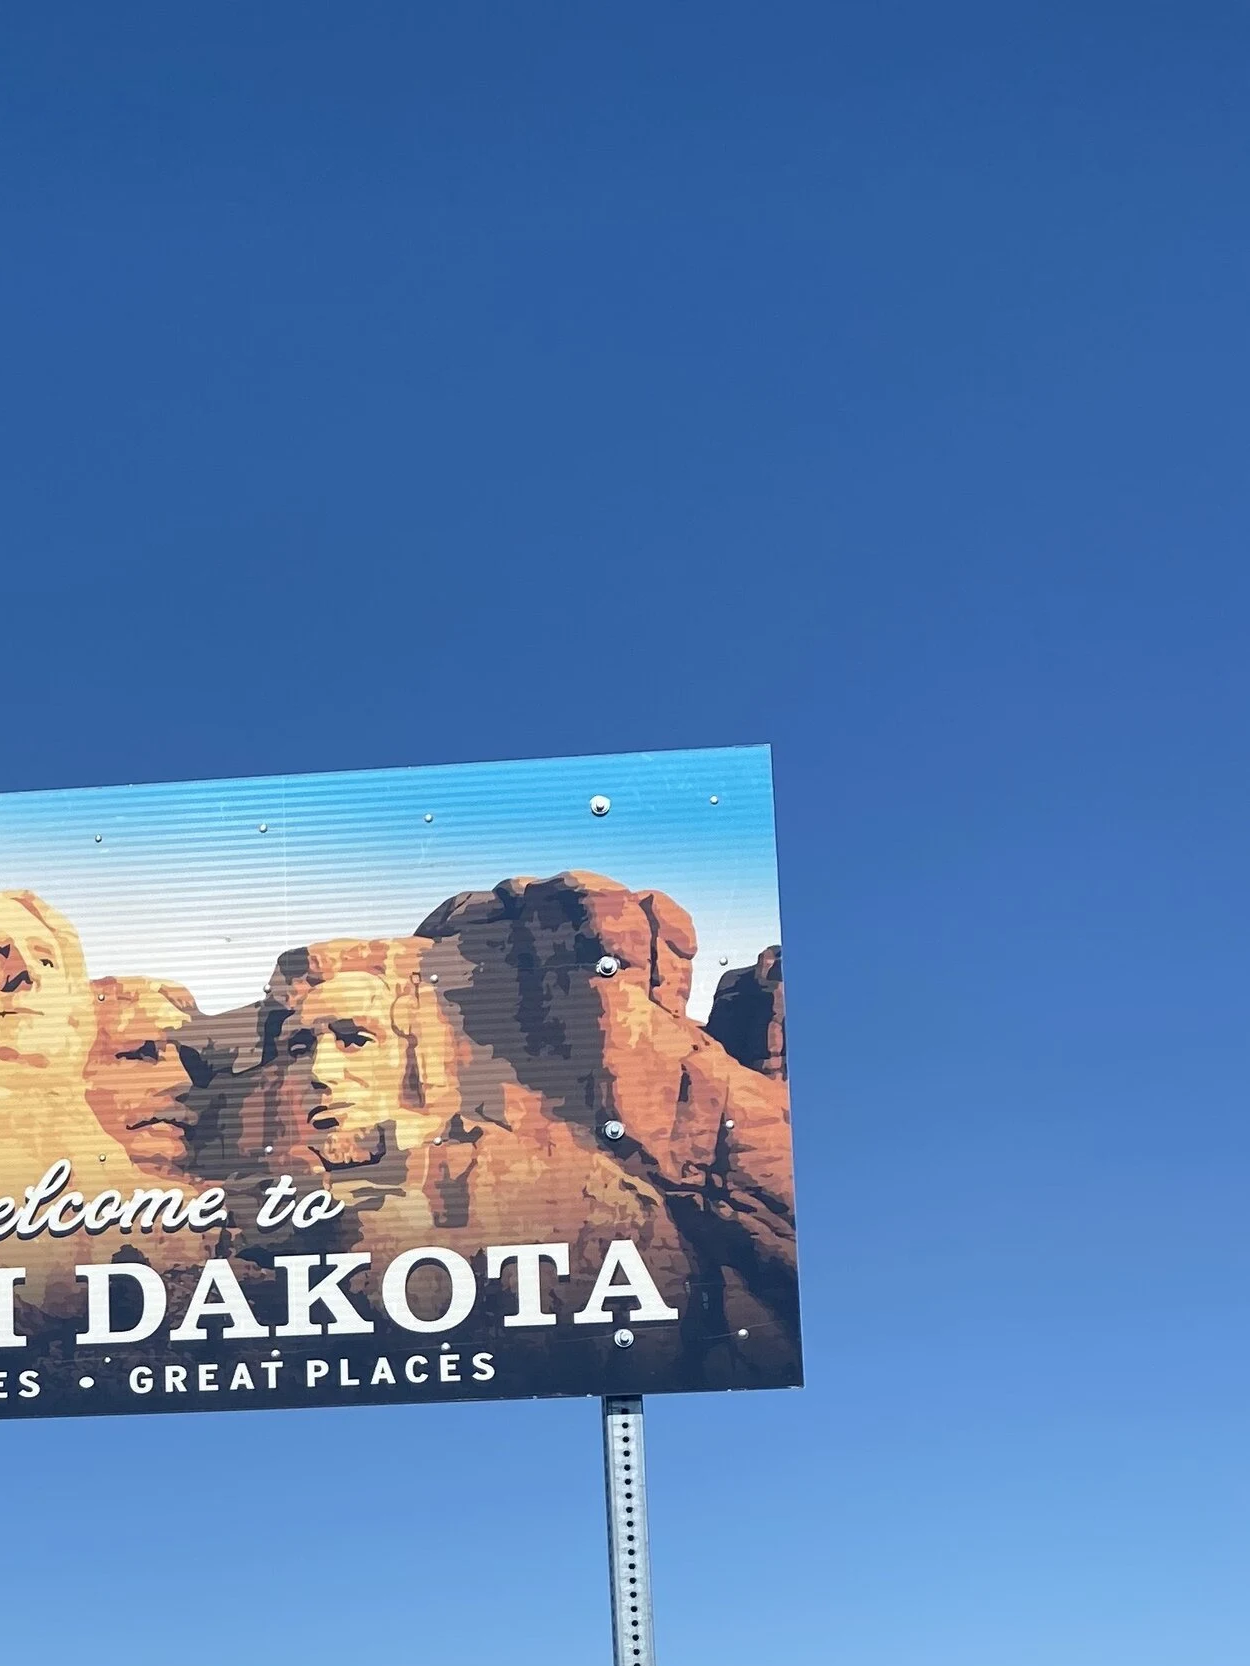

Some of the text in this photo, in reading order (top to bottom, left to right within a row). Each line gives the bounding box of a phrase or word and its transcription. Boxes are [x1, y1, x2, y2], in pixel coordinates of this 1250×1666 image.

[256, 1174, 346, 1229] to
[74, 1239, 679, 1345] DAKOTA
[129, 1361, 284, 1394] GREAT
[306, 1352, 496, 1388] PLACES
